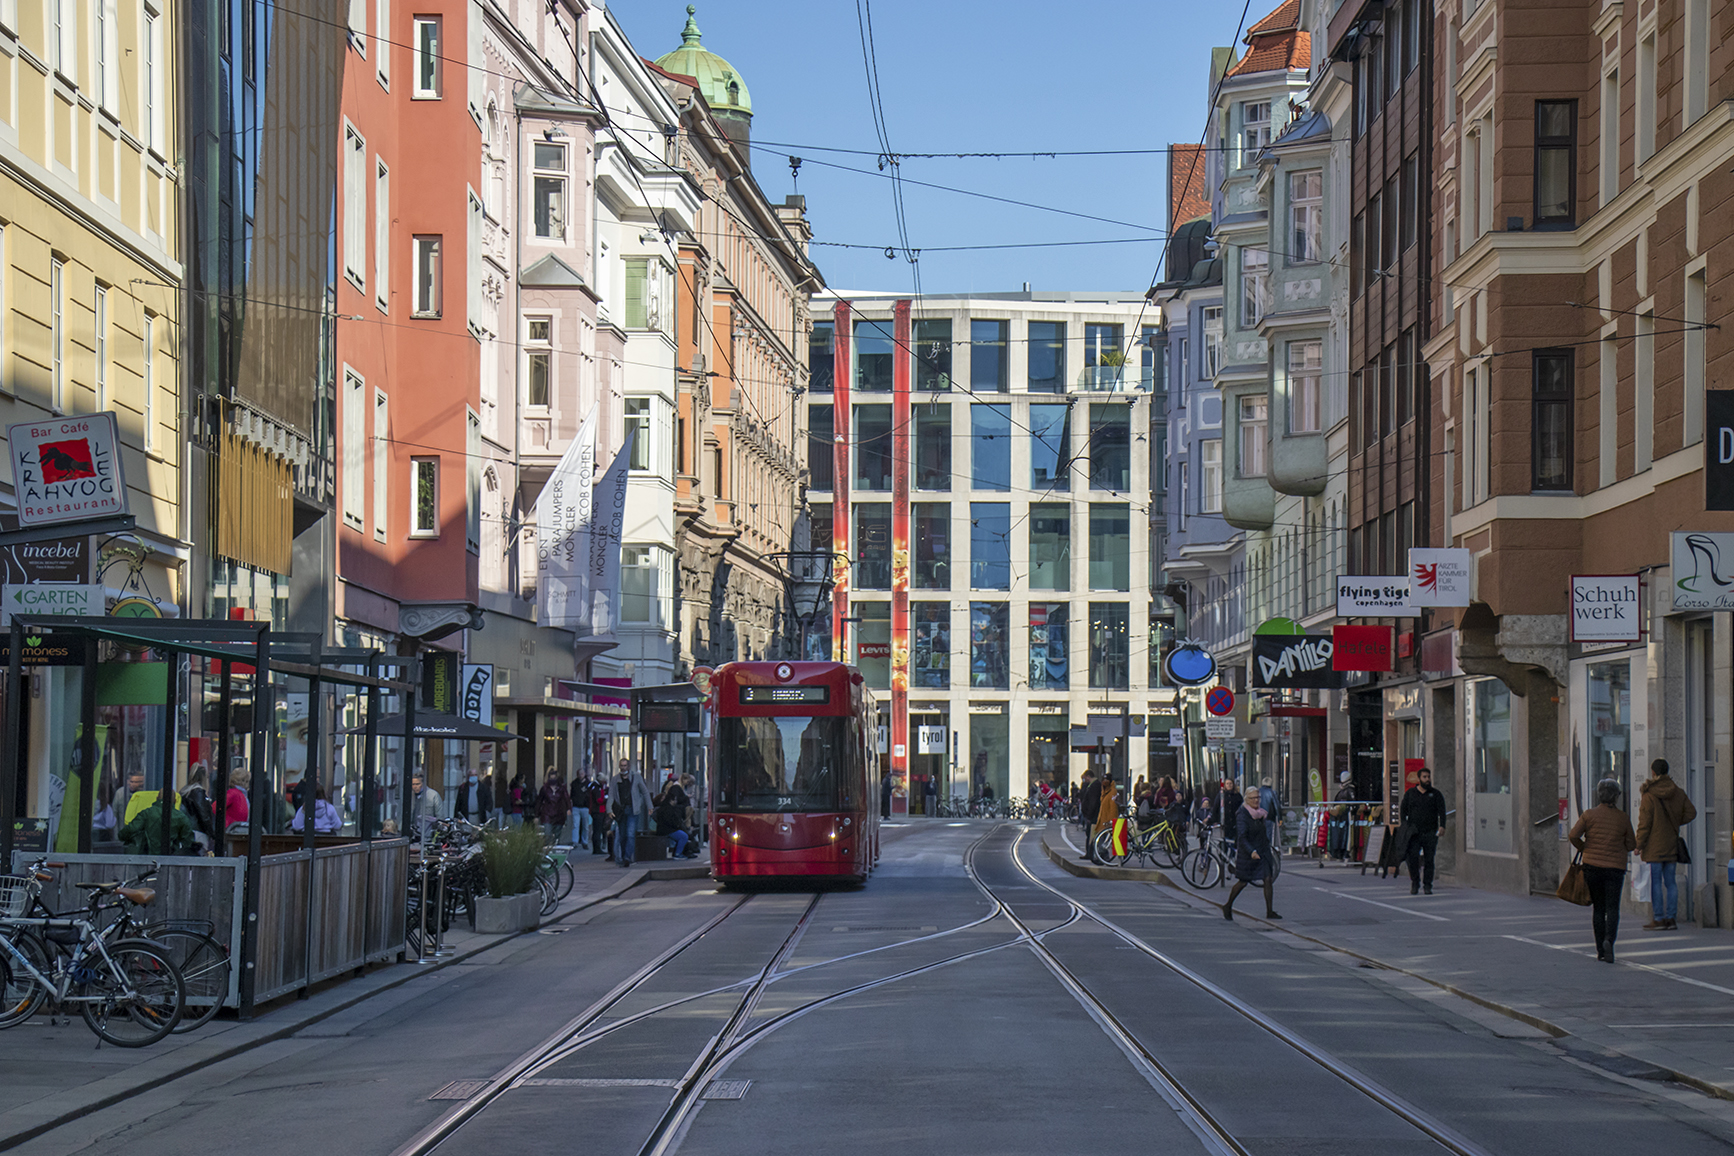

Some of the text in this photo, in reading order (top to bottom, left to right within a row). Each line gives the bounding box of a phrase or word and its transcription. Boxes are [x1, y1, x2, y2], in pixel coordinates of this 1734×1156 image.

[31, 421, 89, 438] Bar Café
[579, 444, 591, 529] JACOB COHEN
[25, 497, 116, 517] Restaurant
[610, 469, 626, 546] JACOB COHEN
[552, 479, 563, 557] PARAJUMPERS
[565, 506, 576, 562] MONCLER
[23, 542, 81, 558] incebel
[539, 539, 548, 570] ETON
[596, 525, 608, 577] MONCLER
[1438, 576, 1452, 584] FÜR
[24, 590, 88, 604] GARTEN
[1340, 585, 1410, 600] flying tige
[1574, 585, 1637, 604] Schuh
[1675, 594, 1709, 608] Corso
[1576, 602, 1625, 620] werk
[2, 648, 68, 656] mmoness
[466, 671, 489, 722] VOLCO
[922, 730, 943, 745] tyrol
[777, 797, 792, 805] 334
